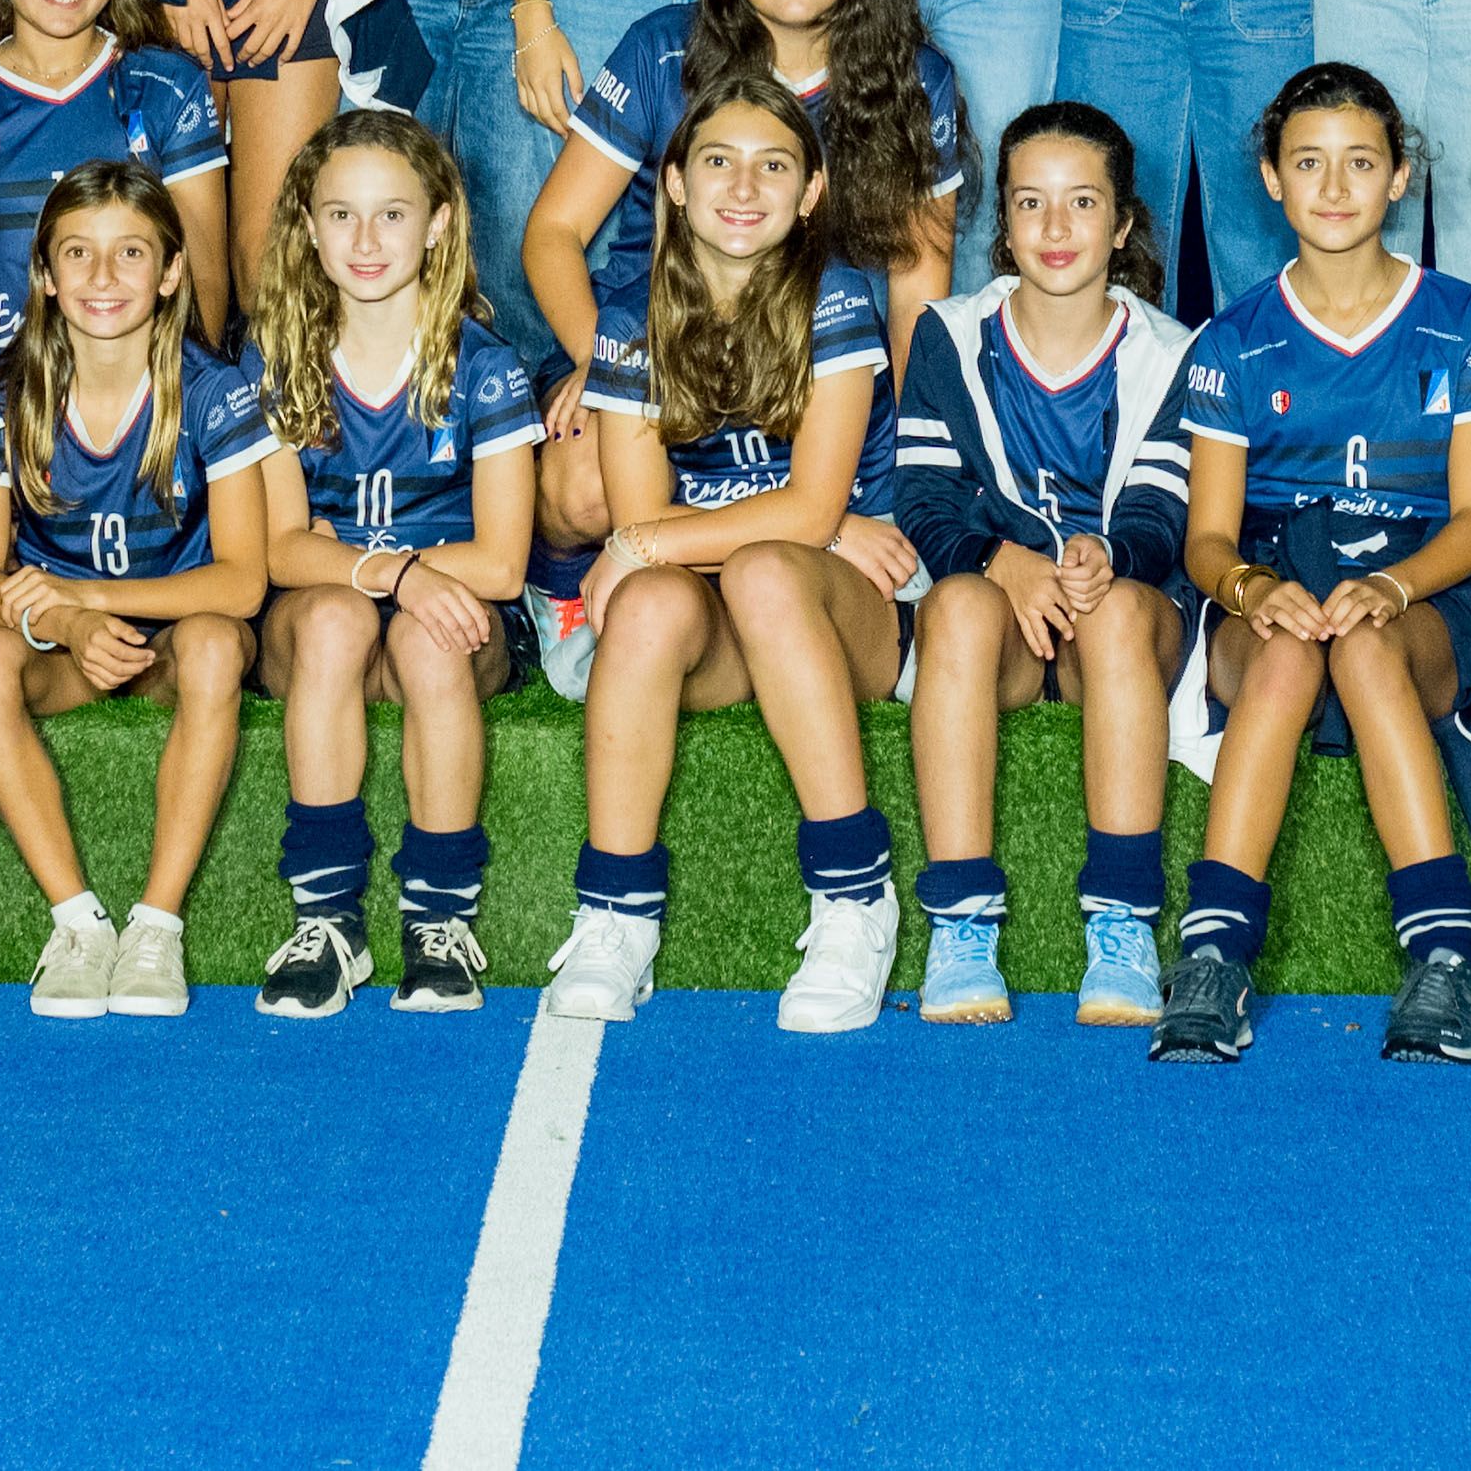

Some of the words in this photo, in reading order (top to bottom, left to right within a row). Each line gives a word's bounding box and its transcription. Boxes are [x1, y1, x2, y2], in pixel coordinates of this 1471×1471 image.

[1345, 434, 1368, 490] 6
[355, 468, 393, 528] 10
[1037, 468, 1062, 524] 5
[90, 512, 130, 576] 13
